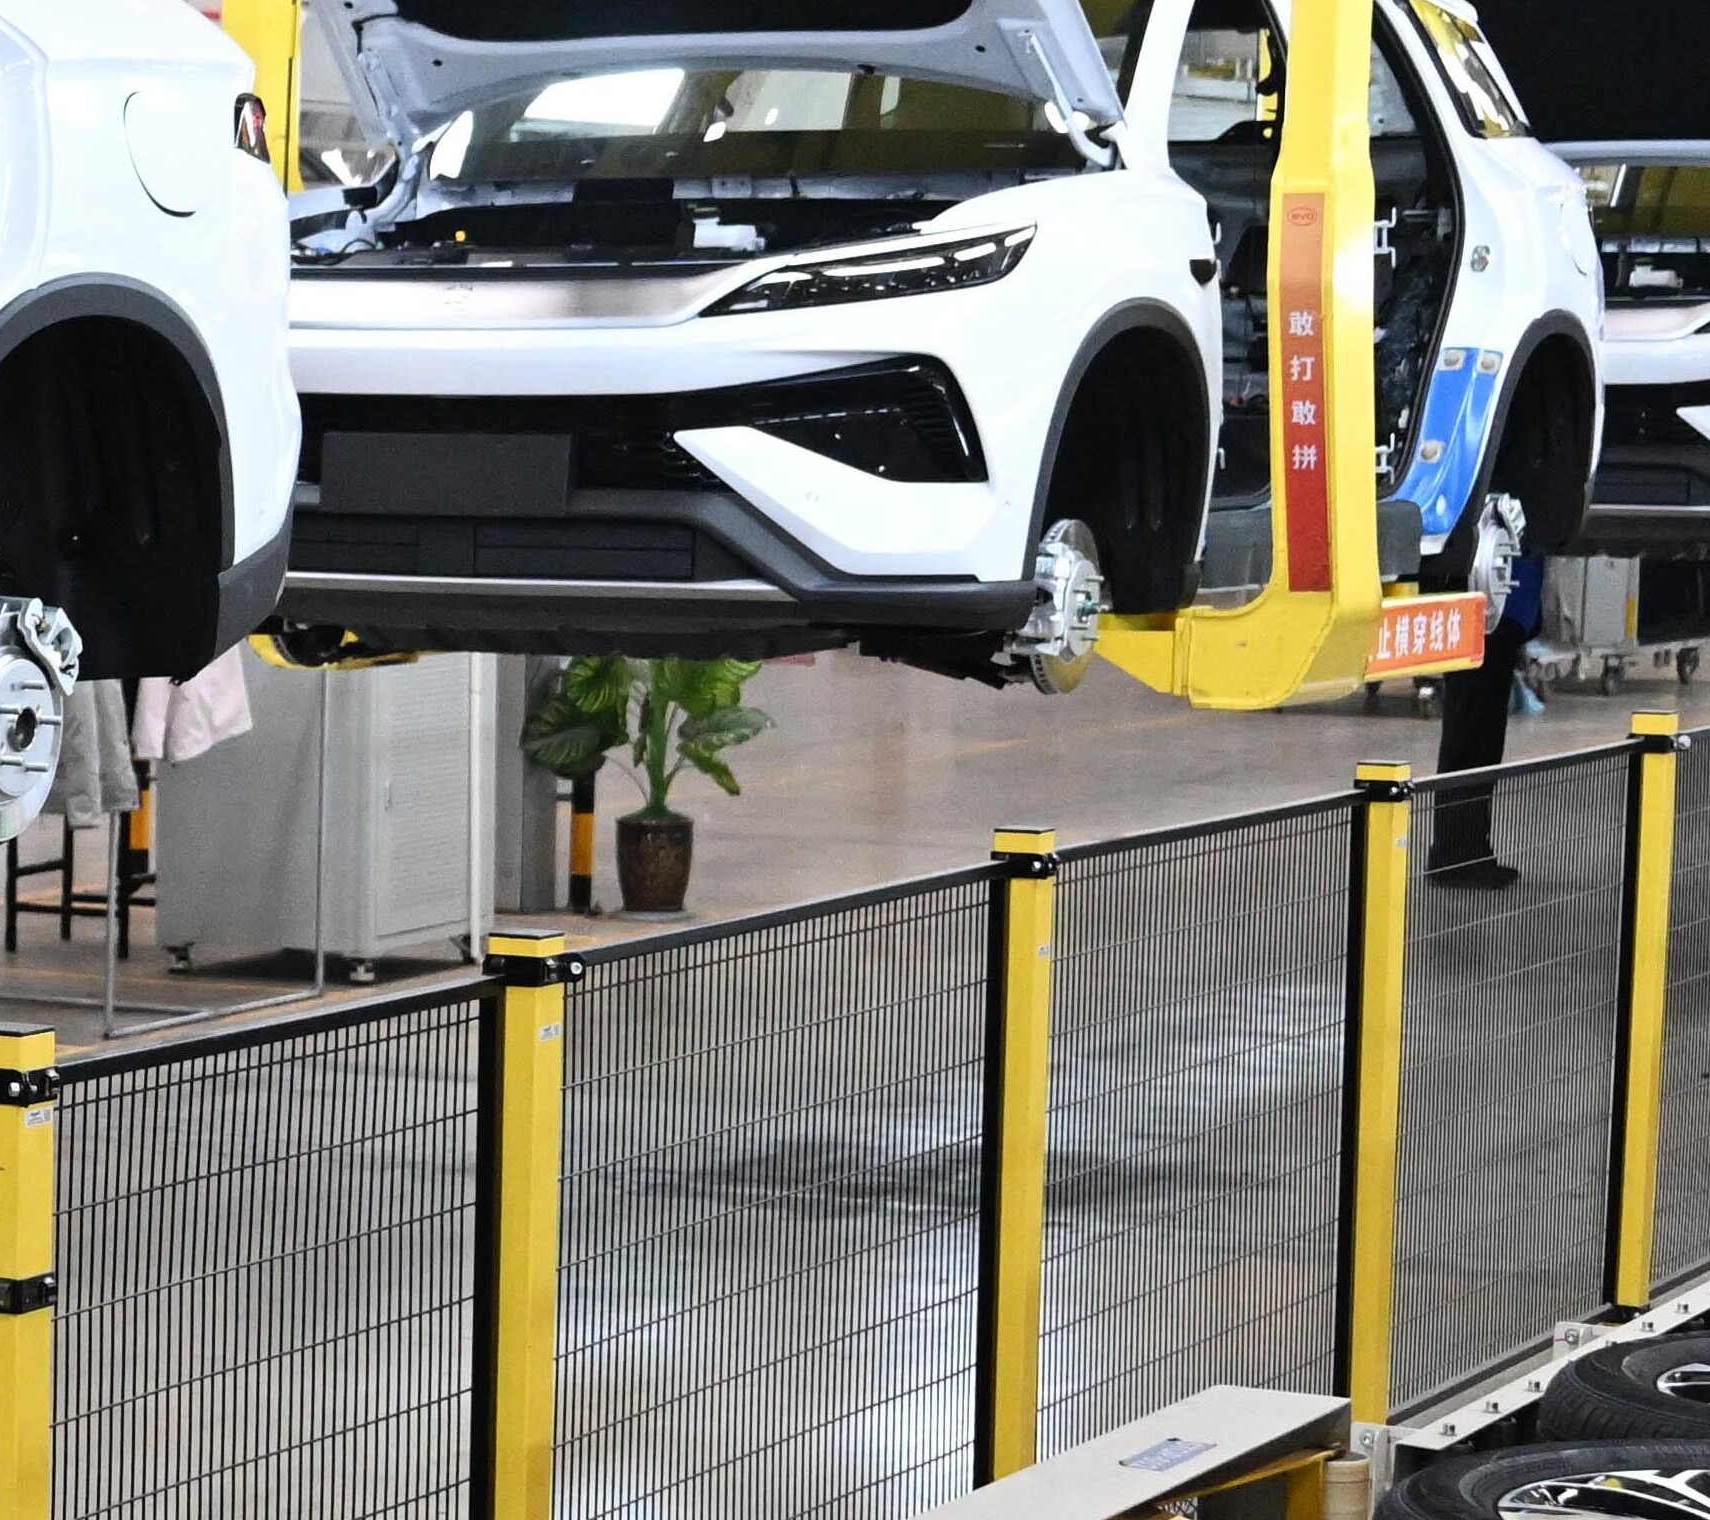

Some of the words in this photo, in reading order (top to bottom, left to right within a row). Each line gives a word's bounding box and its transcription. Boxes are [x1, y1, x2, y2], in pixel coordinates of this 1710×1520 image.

[1288, 310, 1318, 471] 敢打敢拼
[1368, 607, 1461, 662] 止横穿线体
